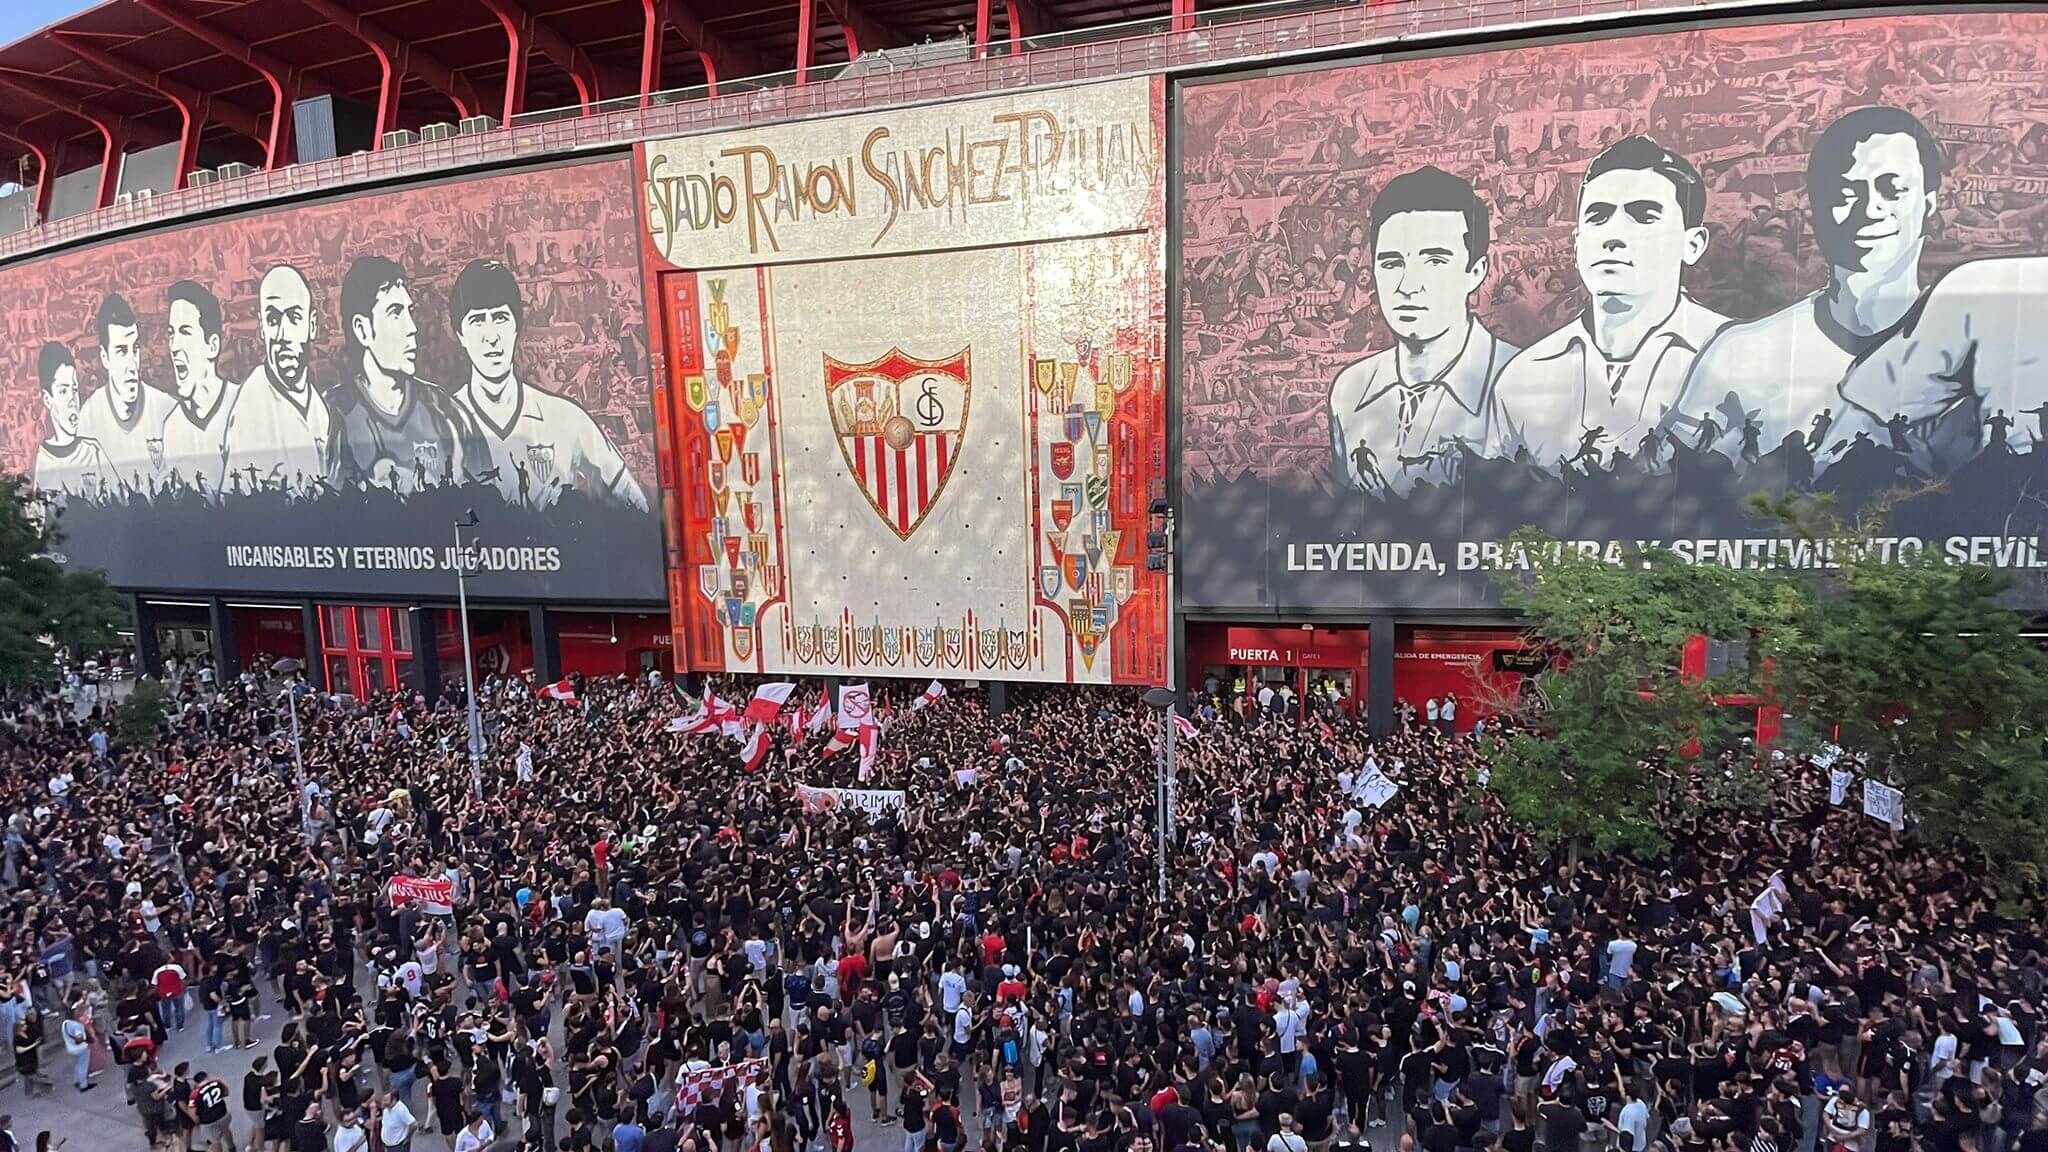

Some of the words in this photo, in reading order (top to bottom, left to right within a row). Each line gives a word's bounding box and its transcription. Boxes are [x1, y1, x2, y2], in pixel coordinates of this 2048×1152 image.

[720, 144, 857, 254] RAMON
[226, 545, 335, 569] INCANSABLES
[336, 546, 349, 569] Y
[354, 546, 436, 570] ETERNOS
[440, 546, 561, 572] JUGADORES
[1287, 542, 1446, 577] LEYENDA,
[1230, 649, 1279, 661] PUERTA
[1286, 650, 1291, 661] 1
[407, 969, 416, 981] 9
[202, 1087, 222, 1108] 12
